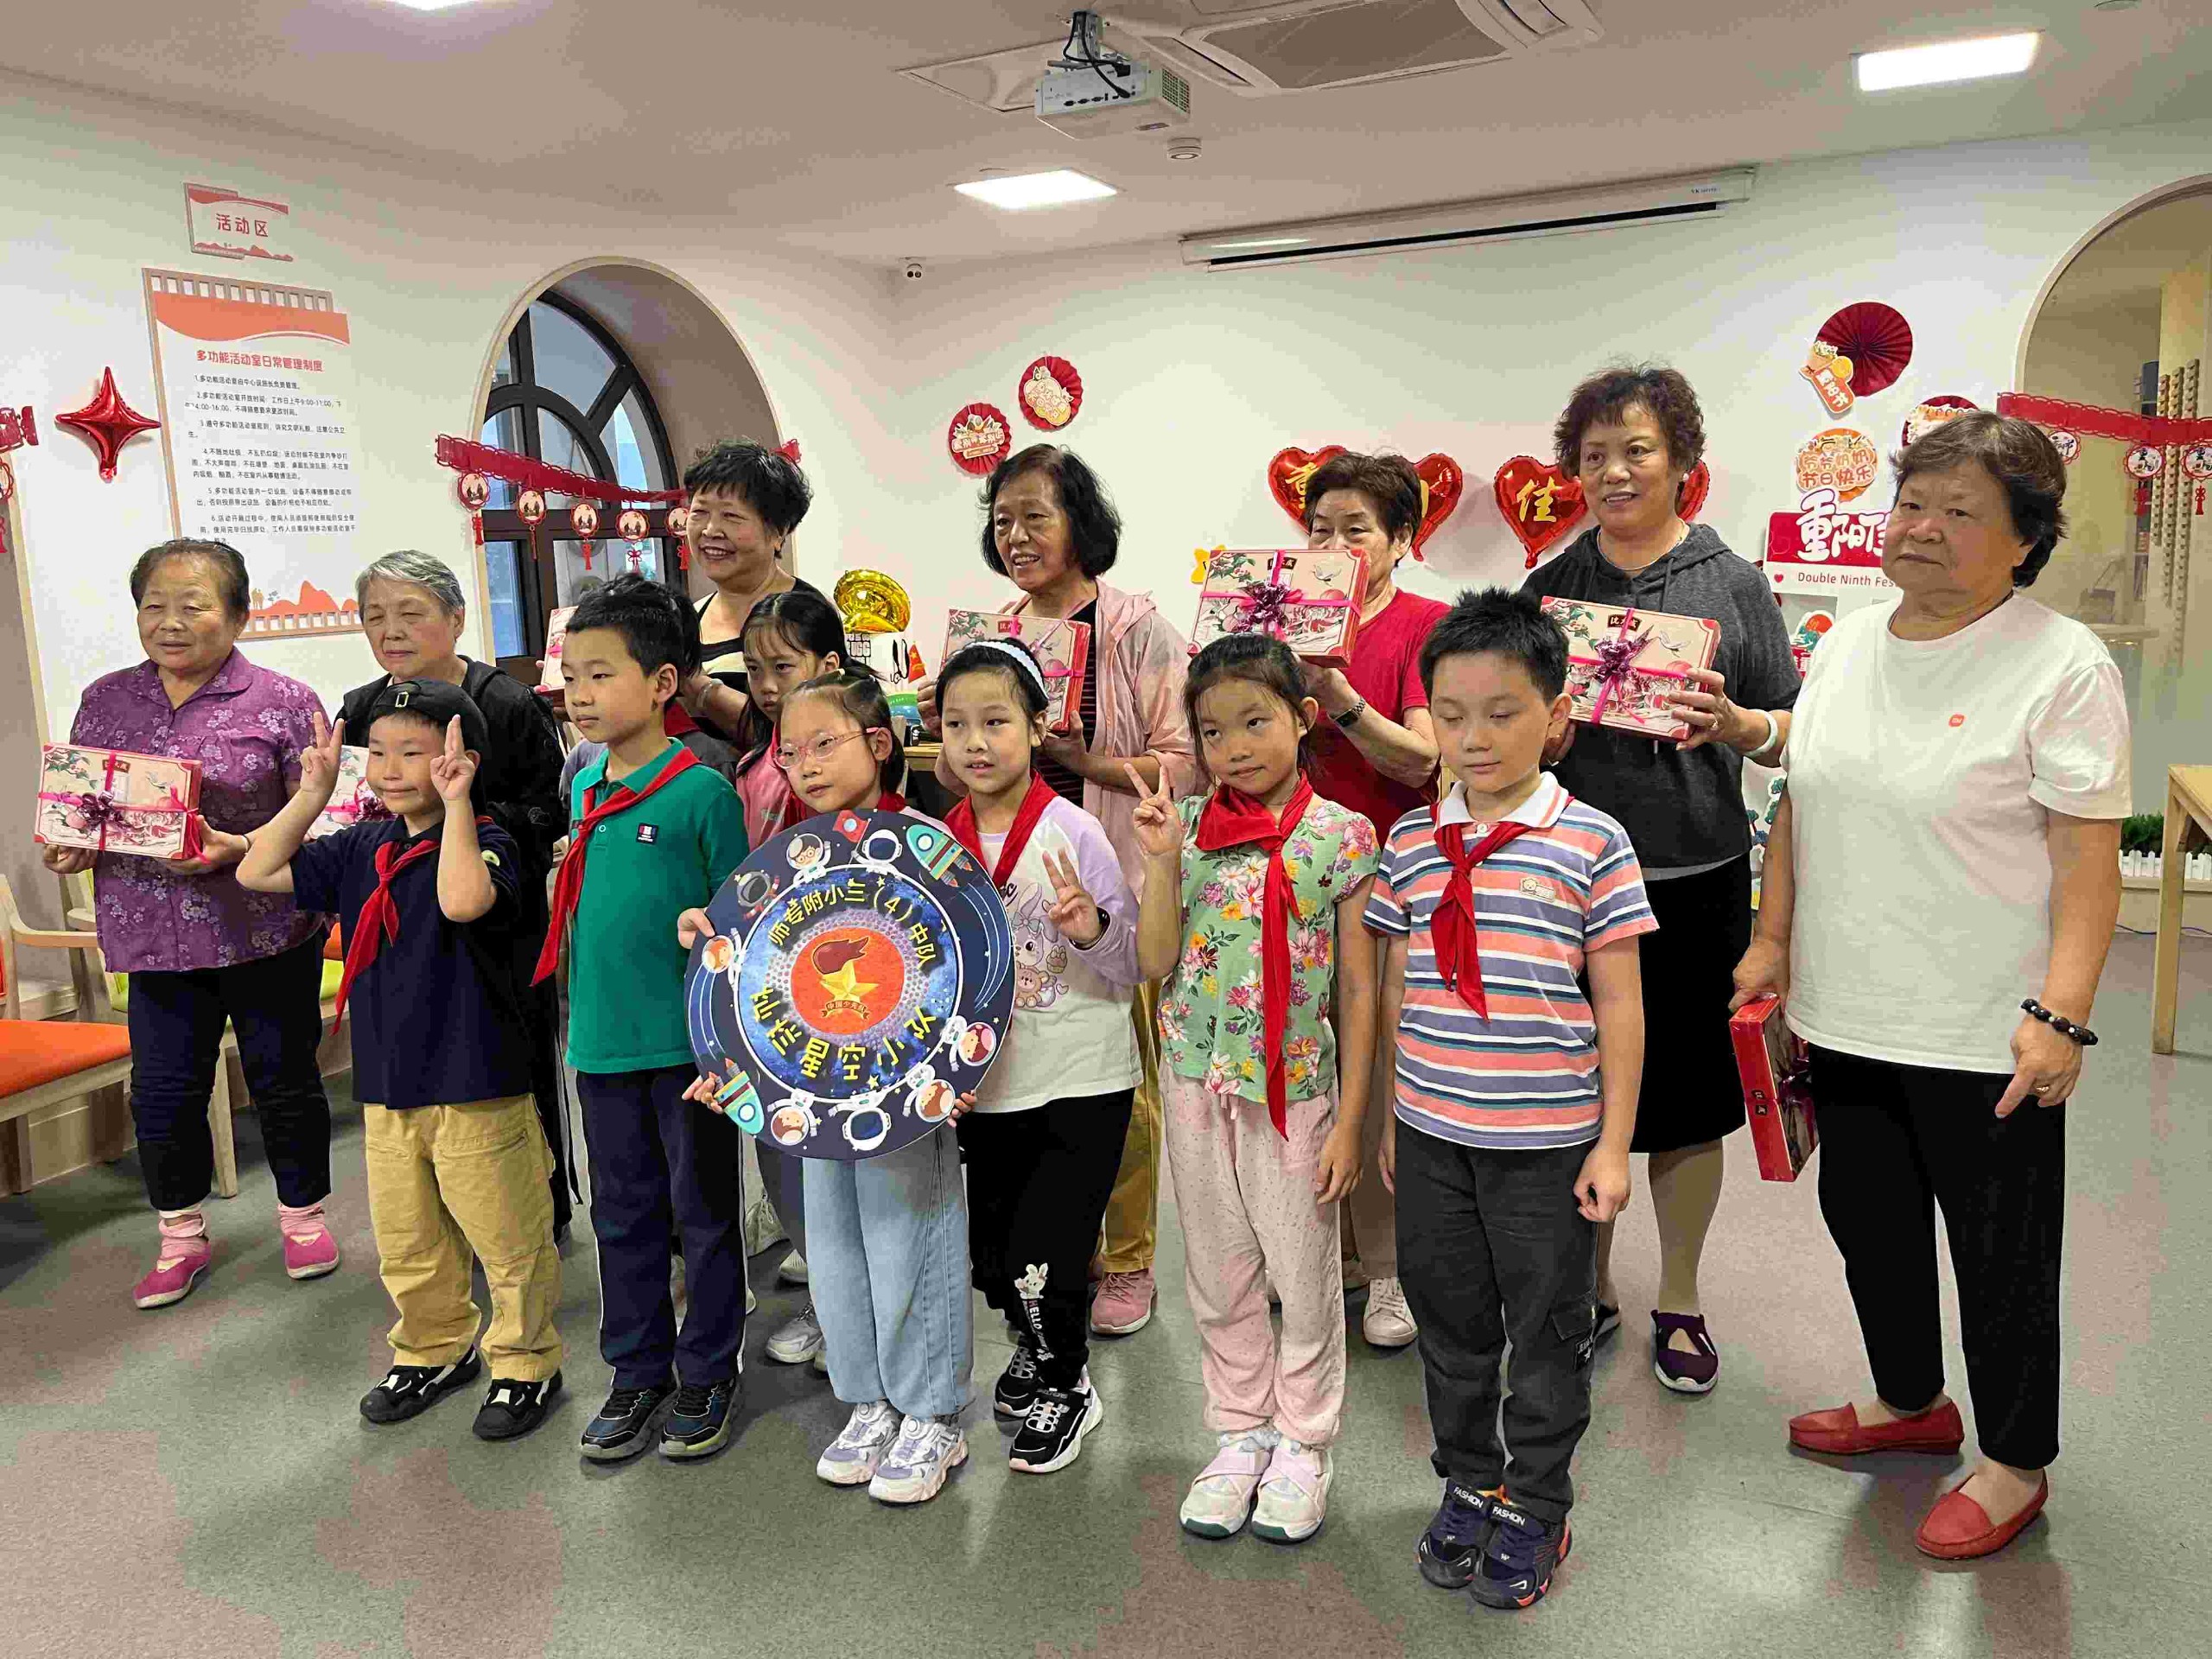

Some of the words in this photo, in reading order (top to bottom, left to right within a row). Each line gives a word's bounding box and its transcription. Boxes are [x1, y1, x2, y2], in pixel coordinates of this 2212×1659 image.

[216, 213, 269, 238] 活动区
[196, 349, 325, 372] 多功能活动室日常管理制度
[1802, 464, 1871, 487] 节日快乐
[1516, 476, 1563, 523] 佳
[1798, 572, 1836, 584] Double
[1840, 575, 1871, 586] Ninth
[1875, 576, 1895, 587] Fes
[750, 986, 937, 1080] 灿烂星空小队
[1028, 1300, 1043, 1330] HELLO
[1453, 1486, 1484, 1509] FASHION
[1492, 1506, 1526, 1526] FASHION
